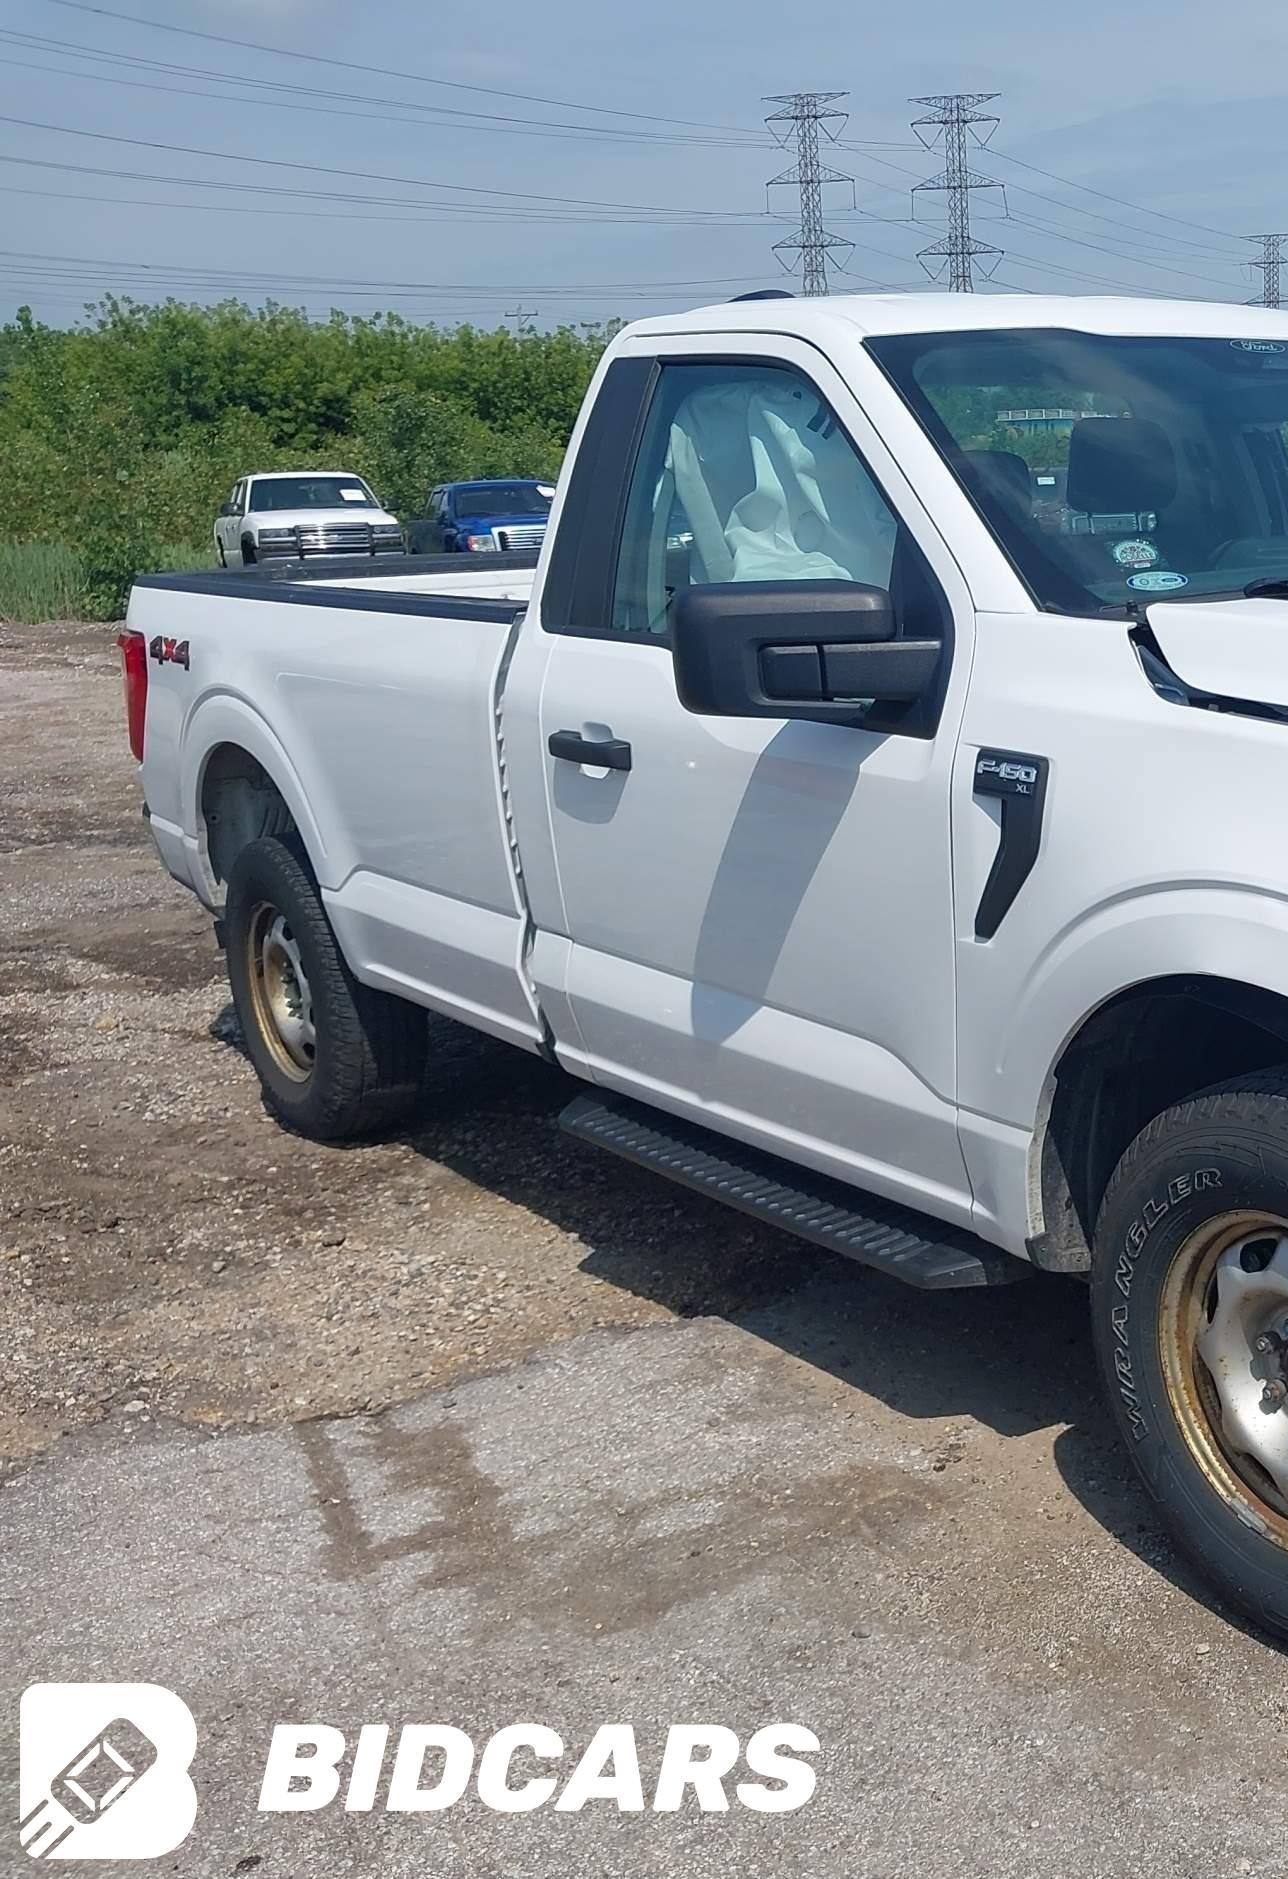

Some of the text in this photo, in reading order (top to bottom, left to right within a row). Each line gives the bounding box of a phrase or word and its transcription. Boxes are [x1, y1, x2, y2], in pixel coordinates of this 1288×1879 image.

[977, 760, 1037, 783] F-150
[1015, 783, 1032, 794] XL
[1111, 1167, 1223, 1442] WRANGLER
